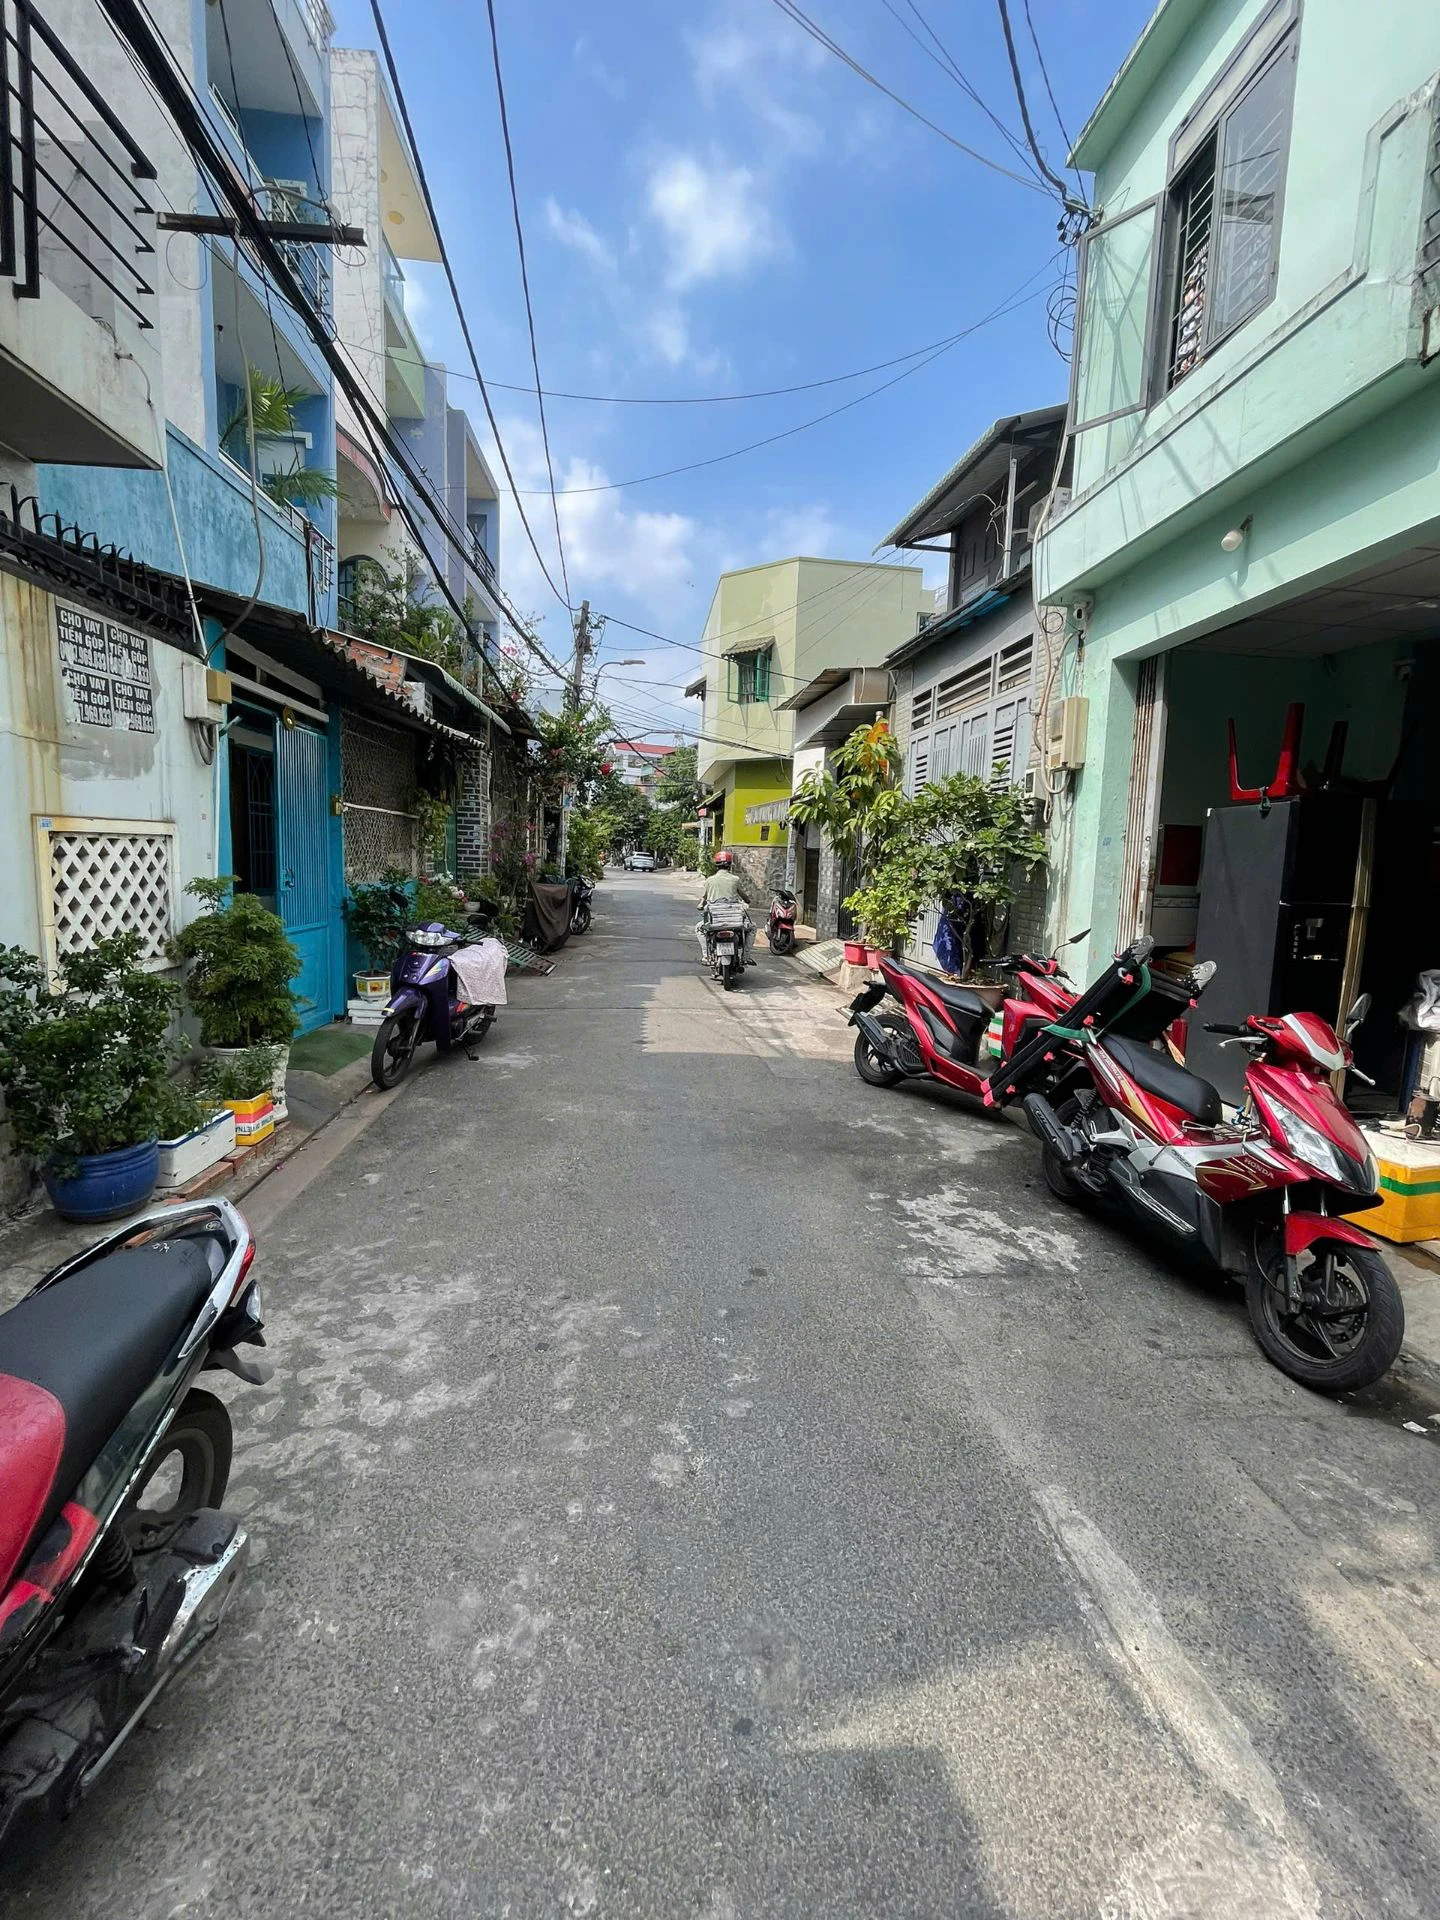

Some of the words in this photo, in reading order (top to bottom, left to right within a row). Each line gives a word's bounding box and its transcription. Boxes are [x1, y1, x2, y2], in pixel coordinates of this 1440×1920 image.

[60, 609, 81, 628] CHO
[83, 618, 101, 635] VAY
[110, 627, 128, 645] CHO
[130, 635, 145, 651] VAY
[66, 669, 88, 687] CHO
[89, 676, 106, 691] VAY
[115, 682, 133, 697] CHO
[134, 687, 149, 701] VAY
[1244, 1158, 1275, 1180] HONDA
